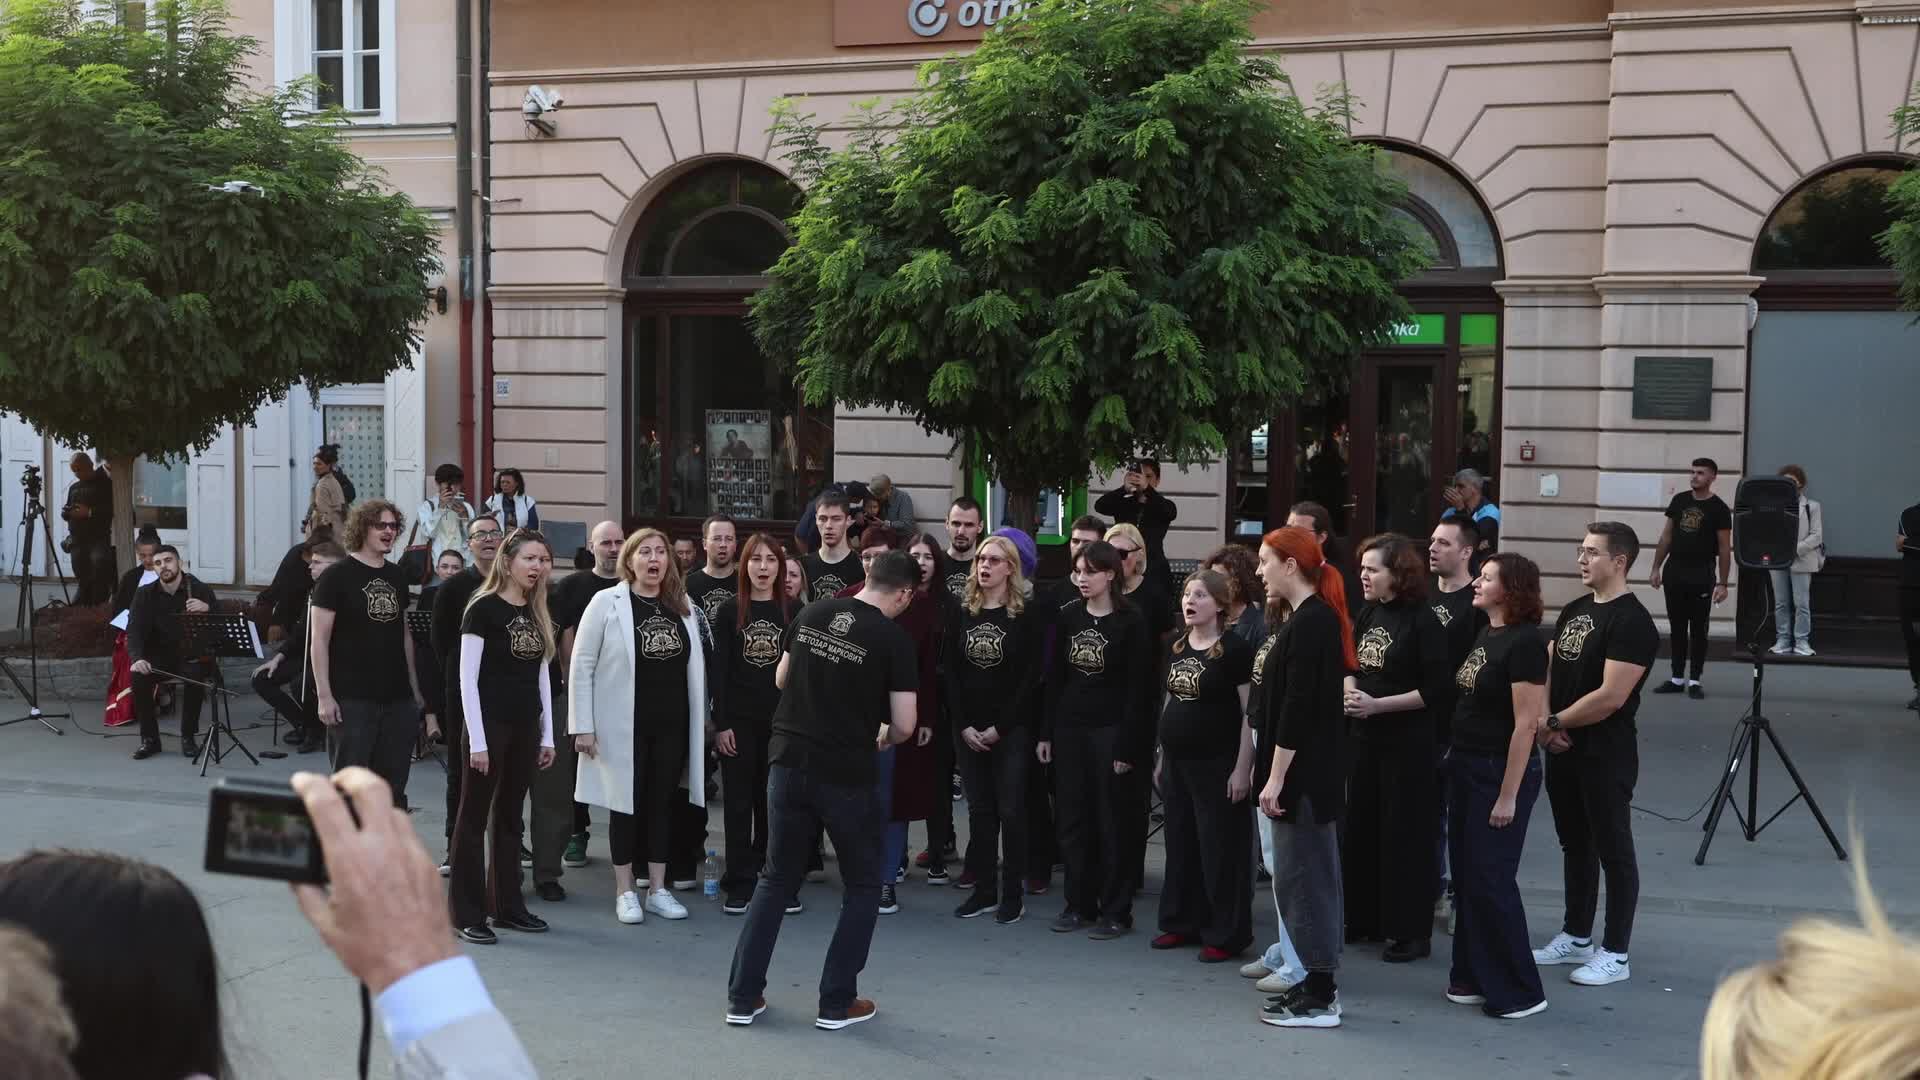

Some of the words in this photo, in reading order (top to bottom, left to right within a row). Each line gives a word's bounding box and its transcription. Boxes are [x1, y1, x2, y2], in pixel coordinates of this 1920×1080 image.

[797, 633, 829, 649] СВЕТОЗАР
[827, 643, 864, 665] МАРКОВИЋ
[809, 647, 828, 658] НОВИ
[827, 653, 841, 664] САД
